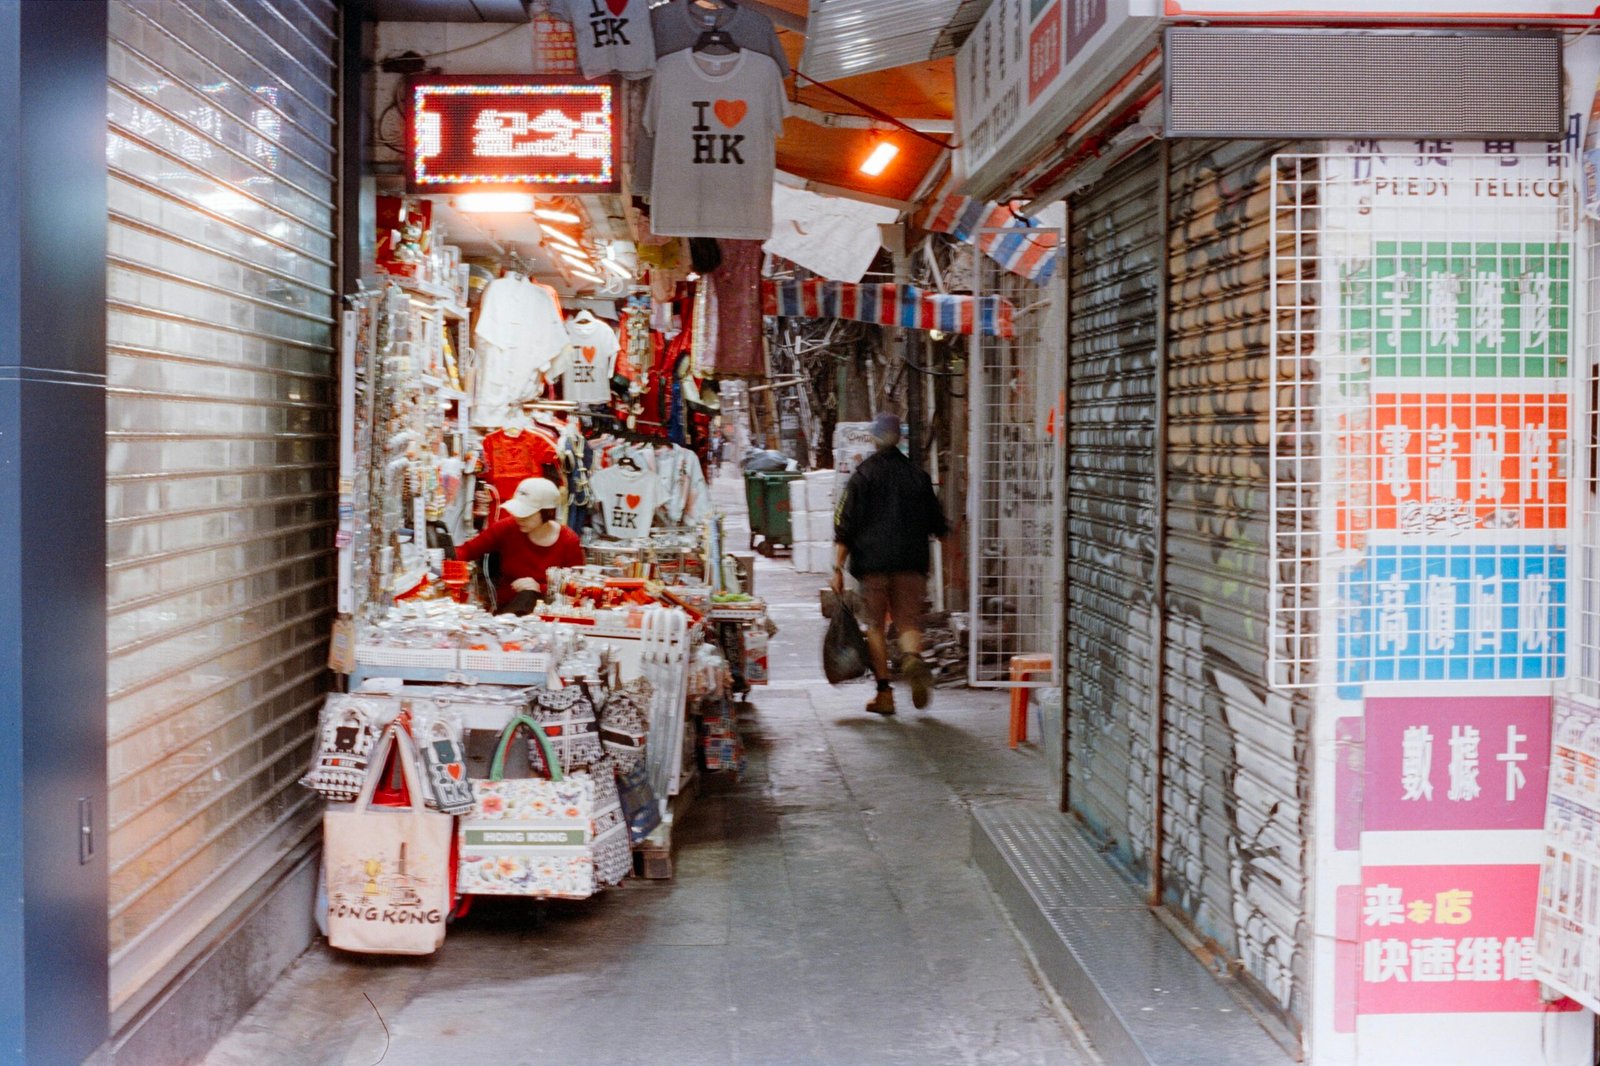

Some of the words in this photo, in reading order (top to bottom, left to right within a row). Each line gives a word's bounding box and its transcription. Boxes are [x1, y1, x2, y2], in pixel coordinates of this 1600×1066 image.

[590, 18, 631, 48] HK
[692, 101, 710, 131] I
[692, 134, 745, 164] HK
[1378, 271, 1552, 348] 手機維修
[573, 365, 596, 383] HK
[1380, 423, 1552, 499] 電話配件
[614, 493, 624, 510] I
[611, 510, 638, 529] HK
[1378, 574, 1551, 650] 高價回收
[1401, 725, 1527, 801] 數據卡
[483, 832, 525, 842] HONG
[526, 832, 568, 842] KONG
[382, 908, 441, 924] KONG
[1364, 884, 1473, 926] 来本店
[1363, 937, 1538, 982] 快速维修
